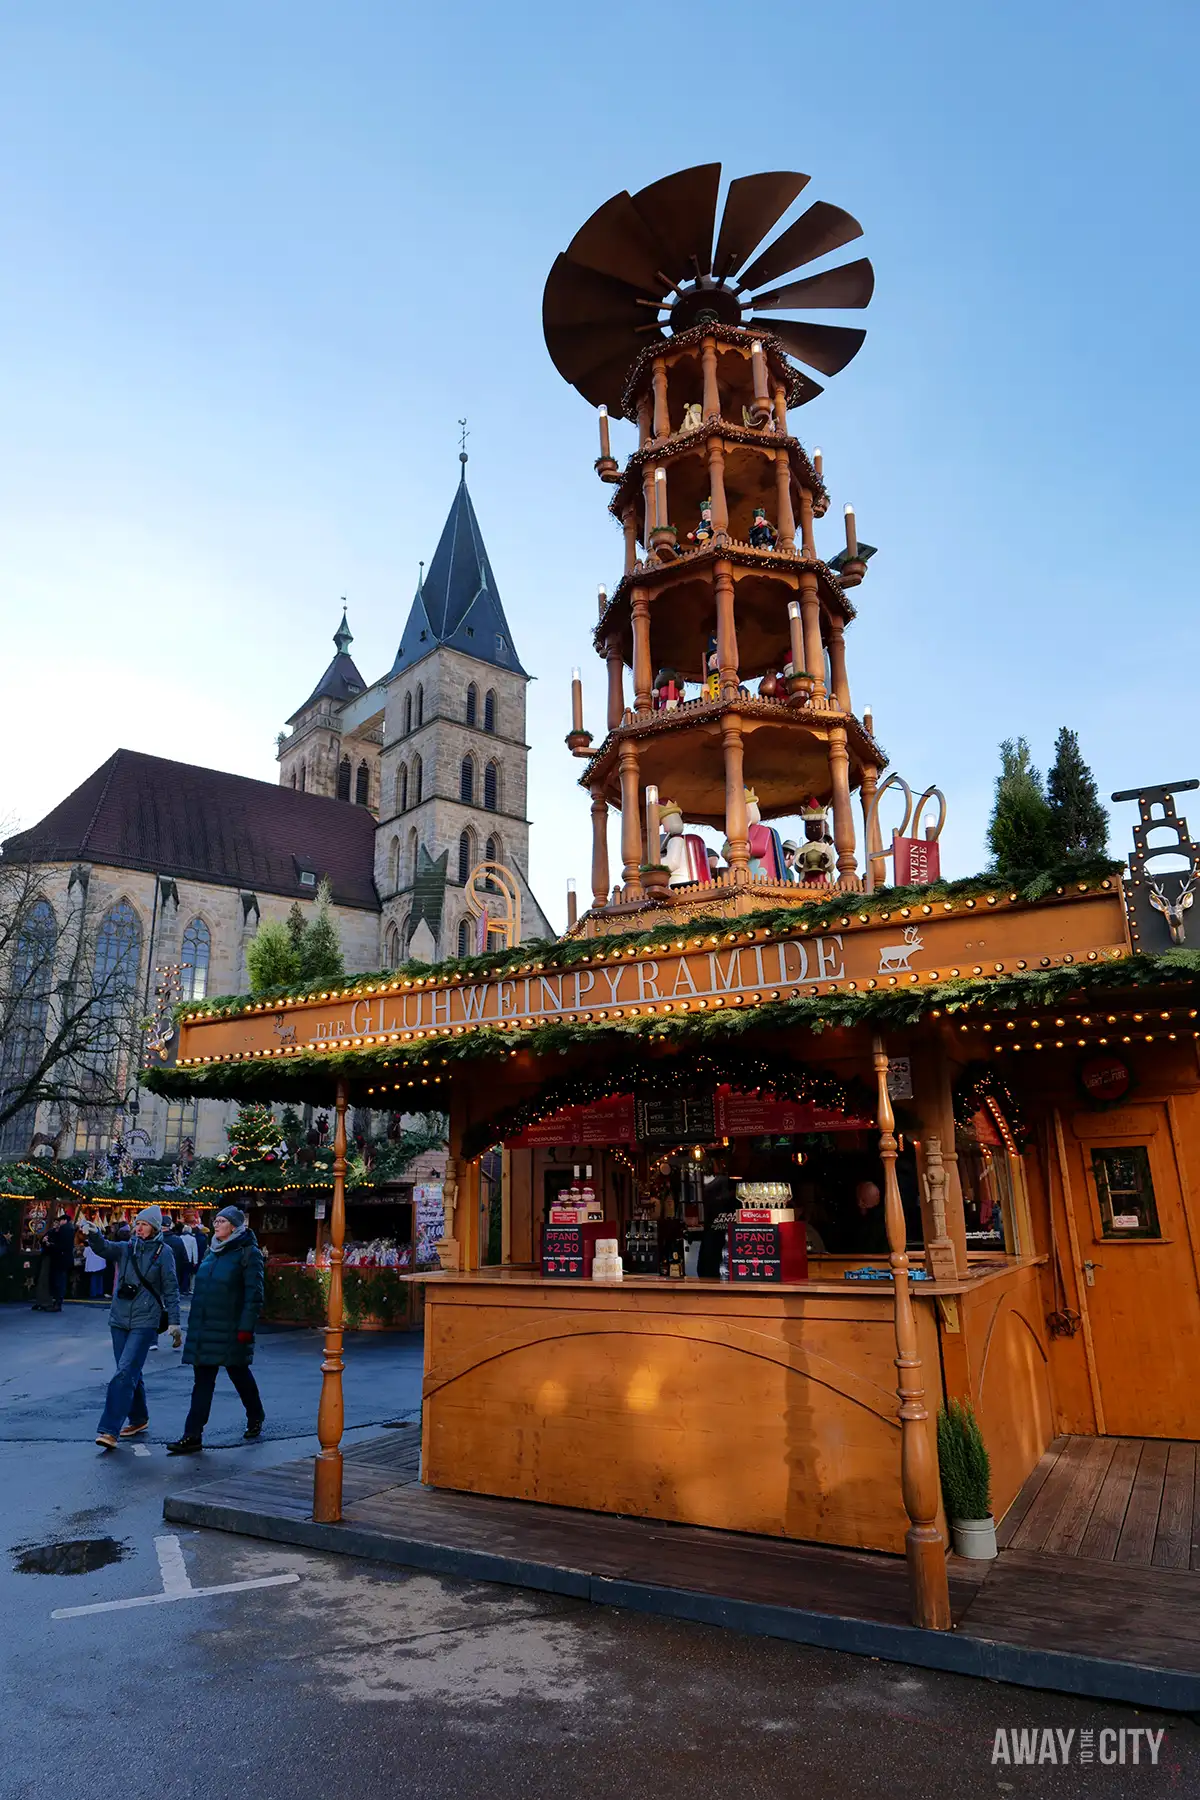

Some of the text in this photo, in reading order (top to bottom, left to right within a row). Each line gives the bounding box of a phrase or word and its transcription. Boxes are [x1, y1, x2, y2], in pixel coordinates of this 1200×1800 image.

[316, 1020, 346, 1039] DIE
[546, 1232, 579, 1241] PFAND
[735, 1232, 775, 1242] PFAND
[546, 1243, 579, 1253] +2.50
[736, 1244, 776, 1255] +2.50
